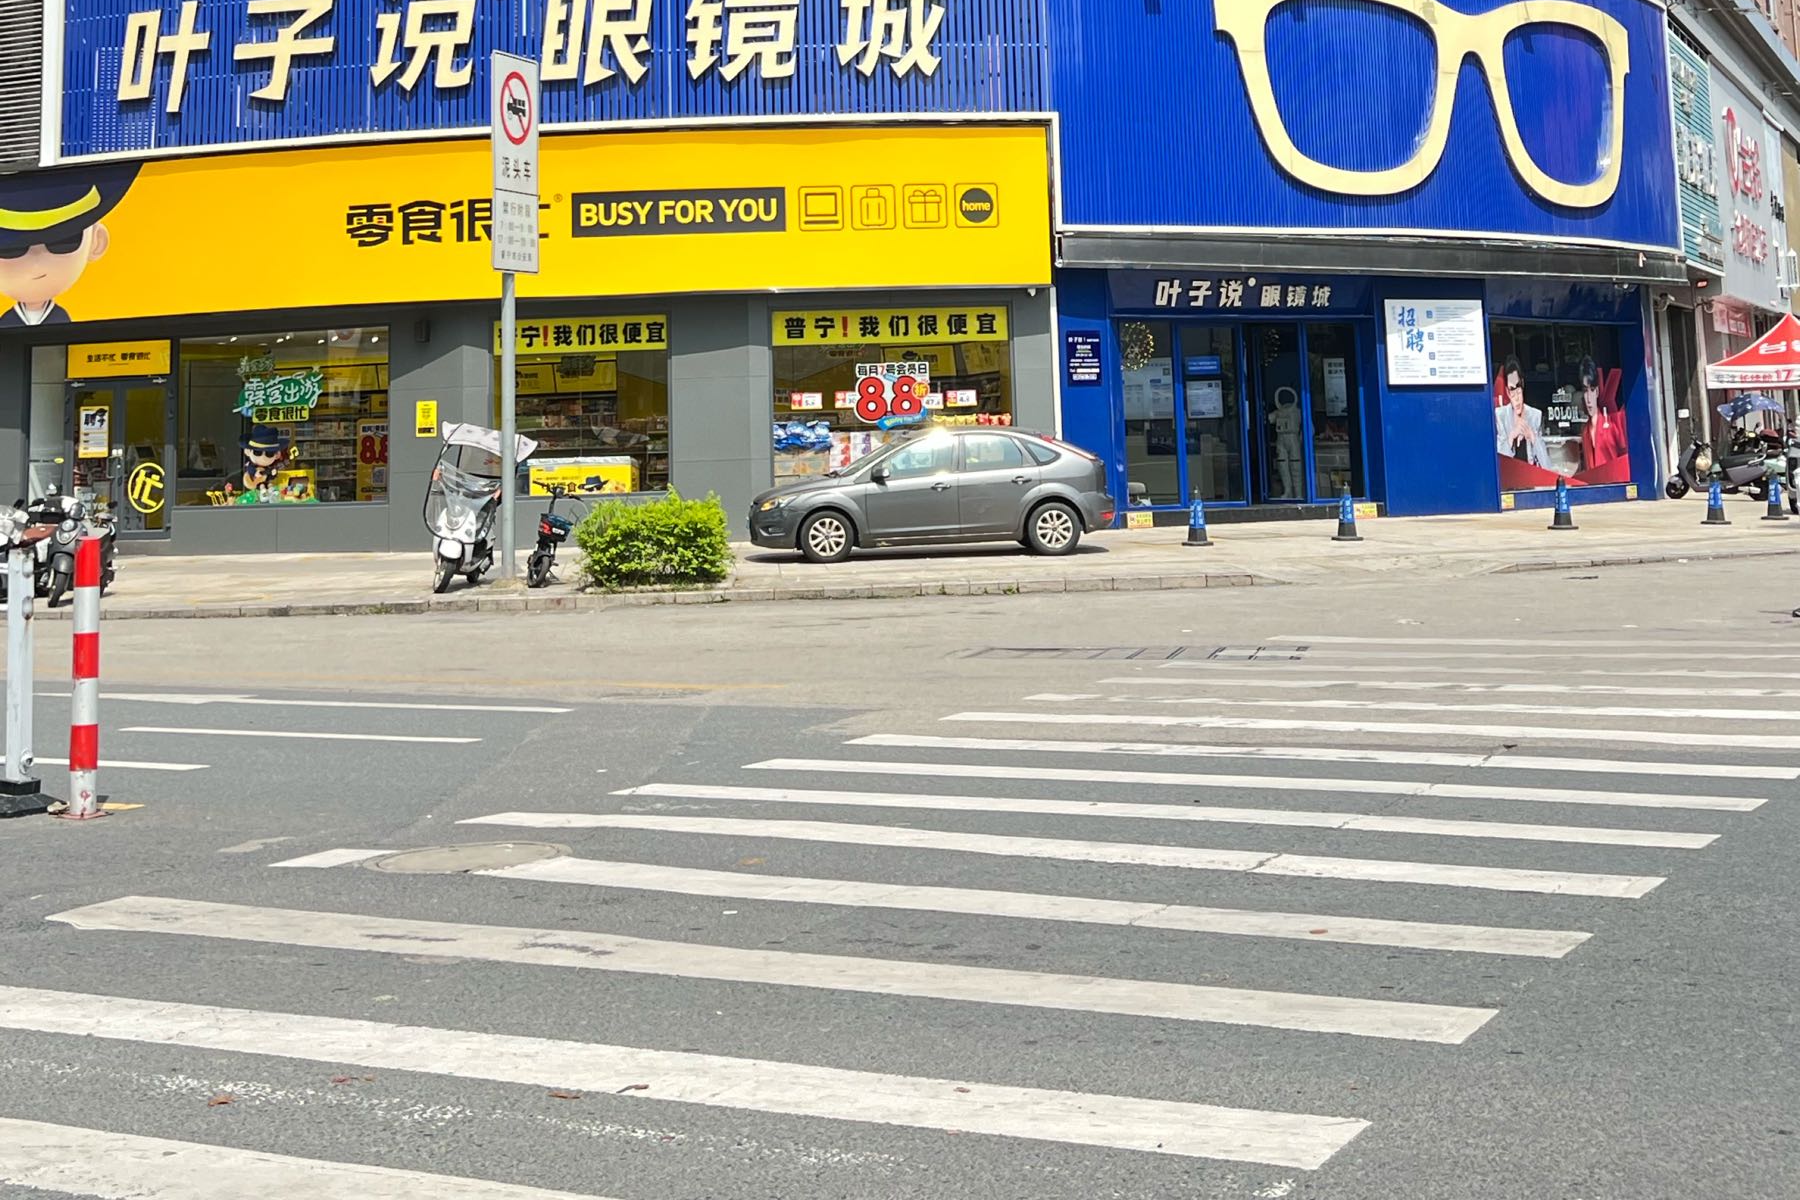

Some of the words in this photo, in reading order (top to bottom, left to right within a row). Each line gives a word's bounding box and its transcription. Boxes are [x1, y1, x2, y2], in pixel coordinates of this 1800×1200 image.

[579, 201, 651, 227] BUSY
[658, 199, 713, 225] FOR
[718, 197, 777, 222] YOU
[961, 200, 991, 212] home
[346, 199, 550, 247] 零食很
[1155, 279, 1244, 308] 叶子说
[1260, 285, 1331, 308] 眼镜城
[784, 313, 998, 339] 普宁！我们很便宜
[857, 363, 927, 376] 每月7号会员日
[912, 381, 930, 399] 折
[255, 406, 308, 421] 零食很忙
